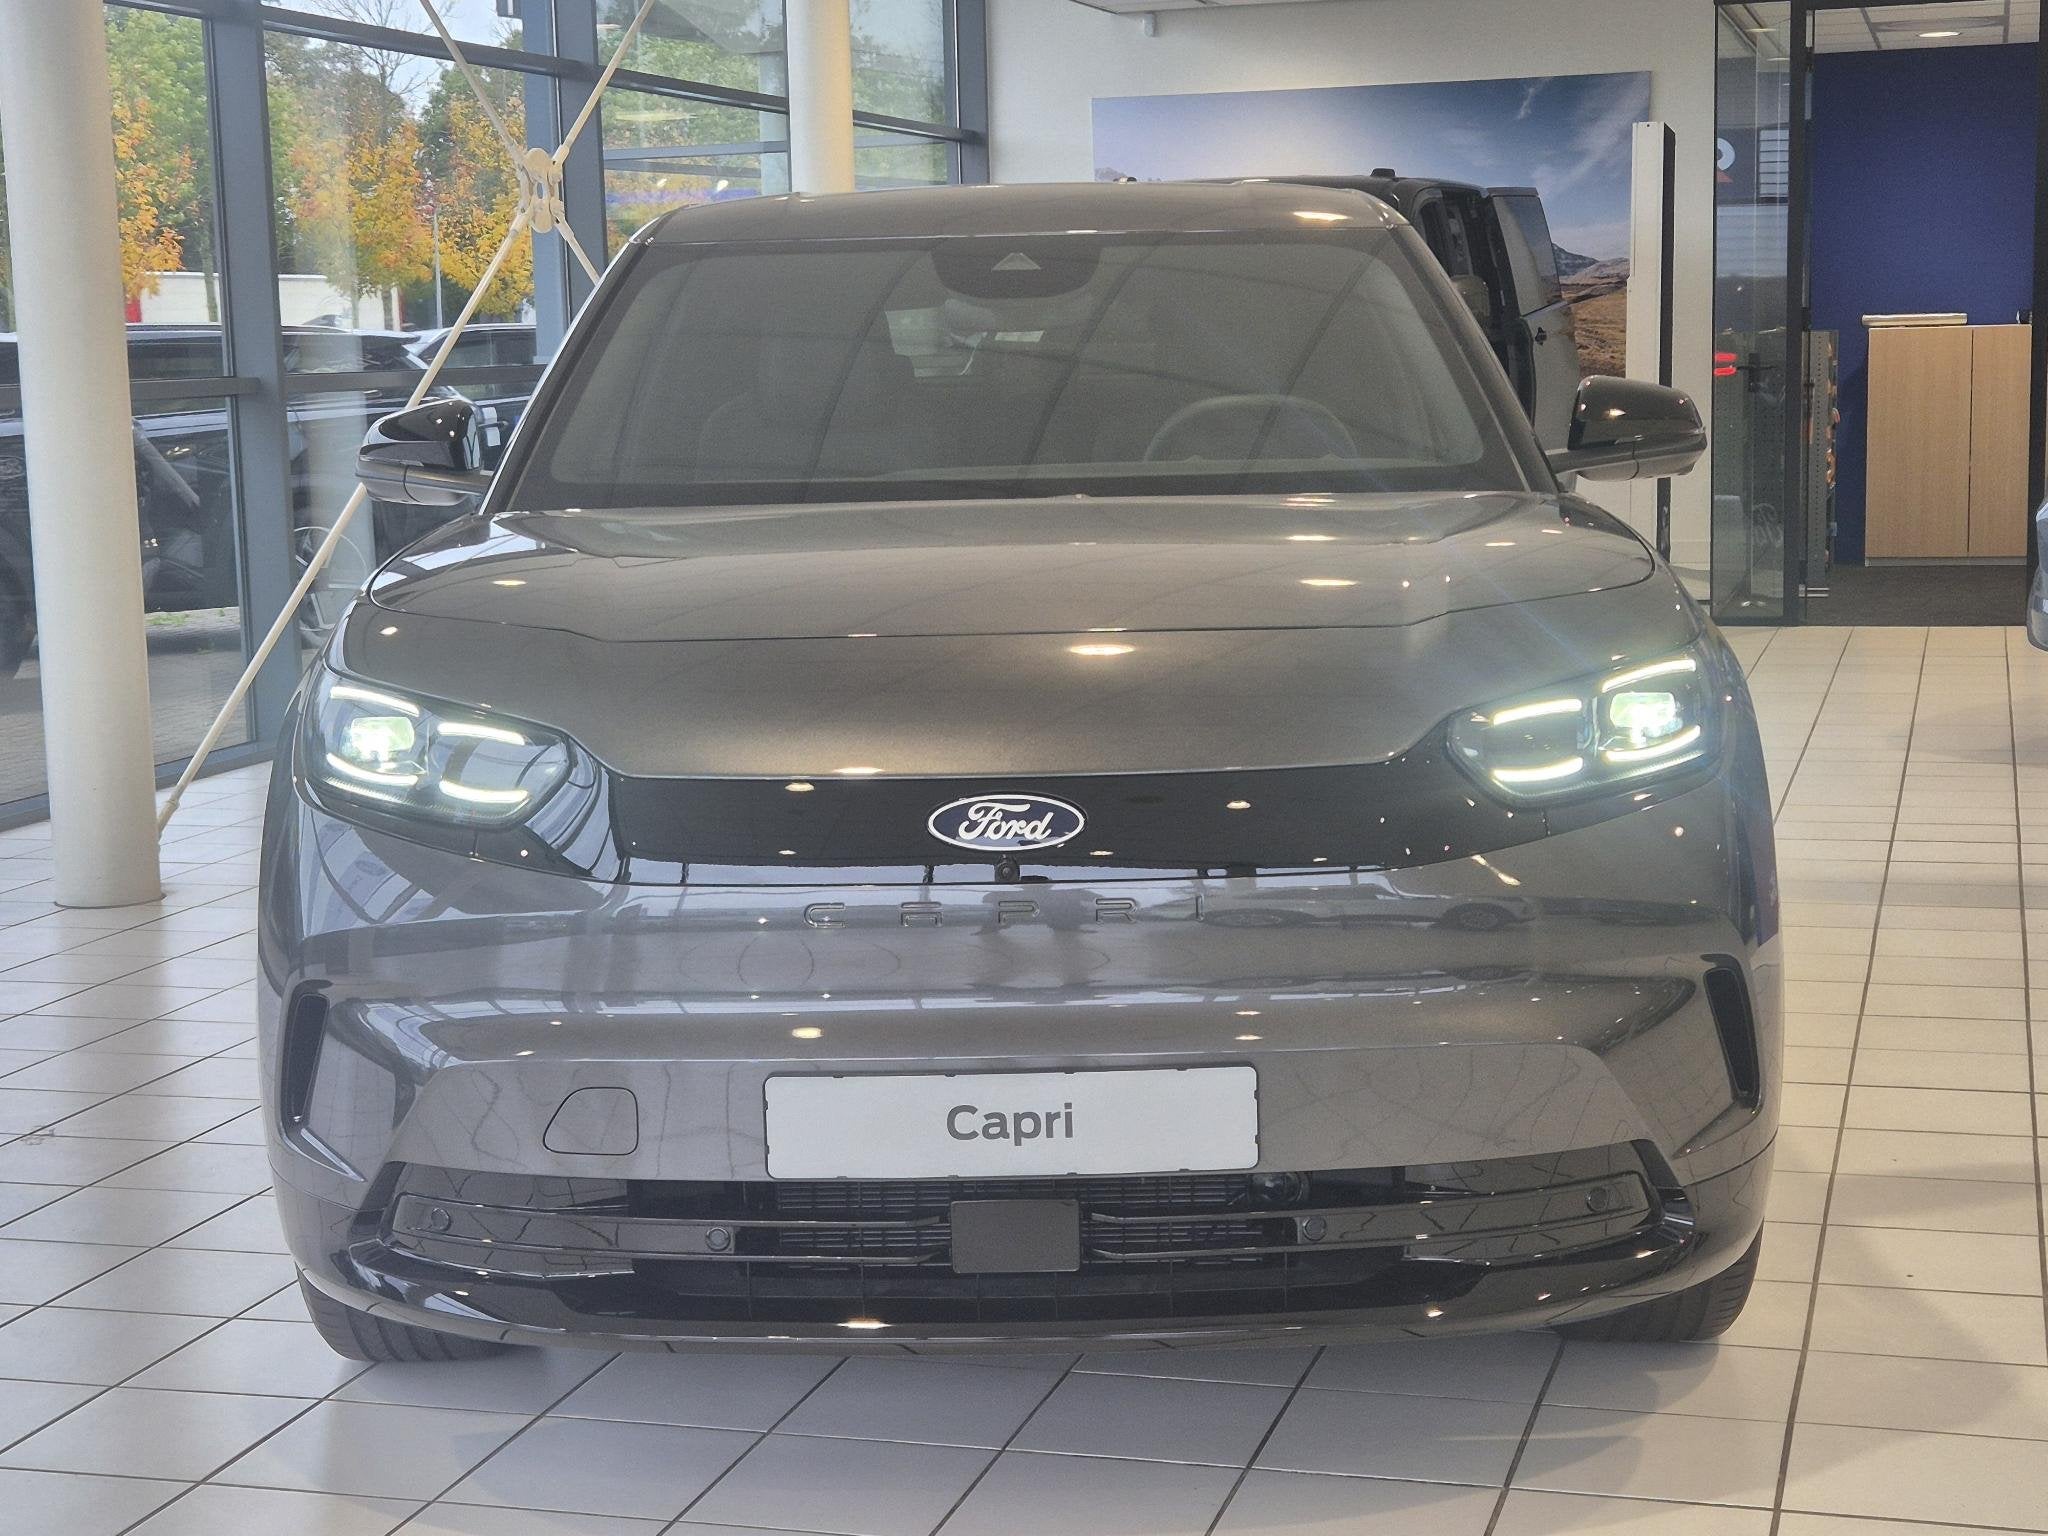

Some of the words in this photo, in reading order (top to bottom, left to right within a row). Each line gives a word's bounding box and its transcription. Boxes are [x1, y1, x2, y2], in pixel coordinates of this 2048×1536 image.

[958, 802, 1054, 840] Ford
[803, 894, 1205, 928] CAPRI
[946, 1102, 1074, 1147] Capri
